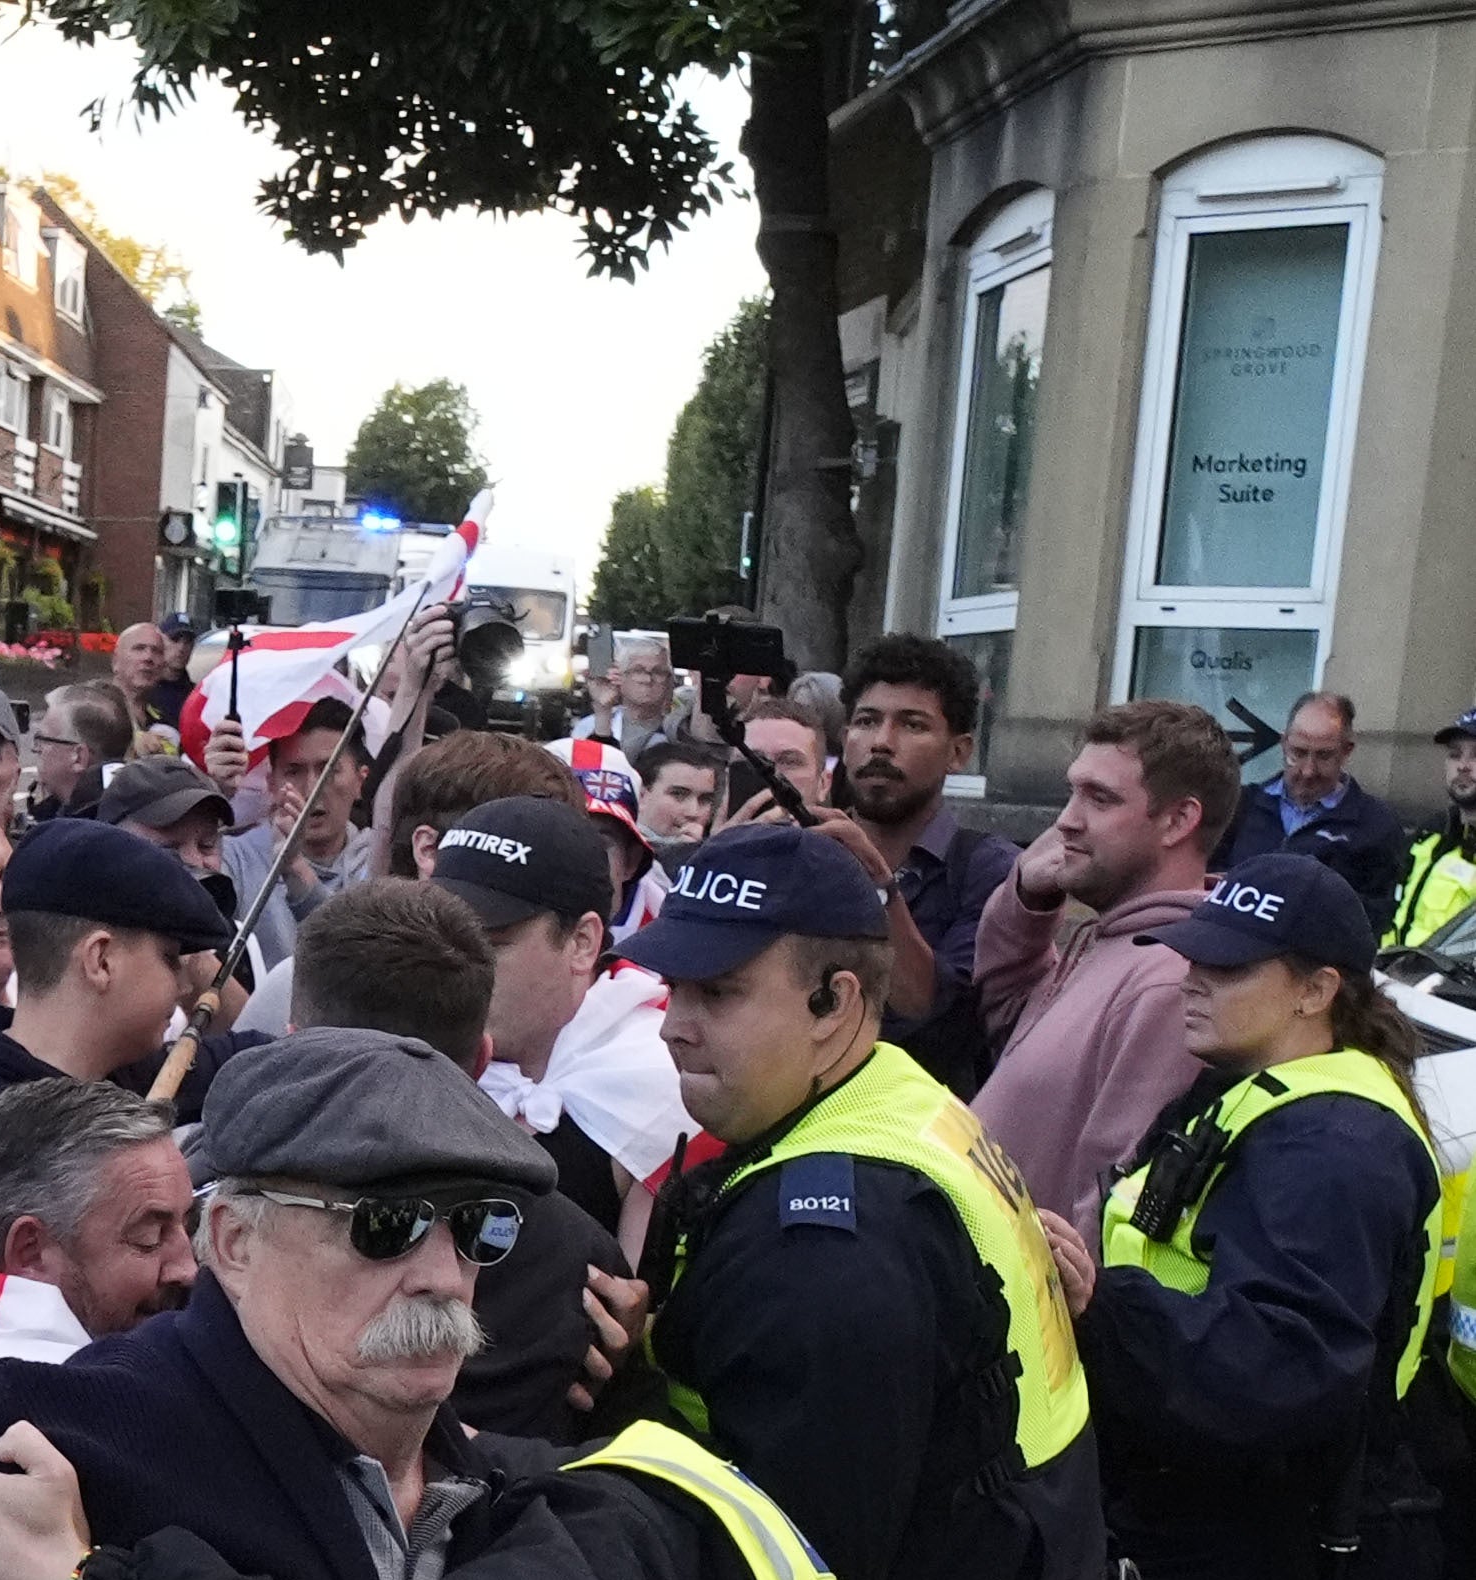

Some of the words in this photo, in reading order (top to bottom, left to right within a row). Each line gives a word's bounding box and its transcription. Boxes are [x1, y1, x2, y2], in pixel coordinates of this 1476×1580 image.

[1191, 453, 1307, 478] Marketing
[1218, 483, 1275, 503] Suite
[1190, 650, 1253, 670] Qualis
[668, 865, 768, 910] OLICE
